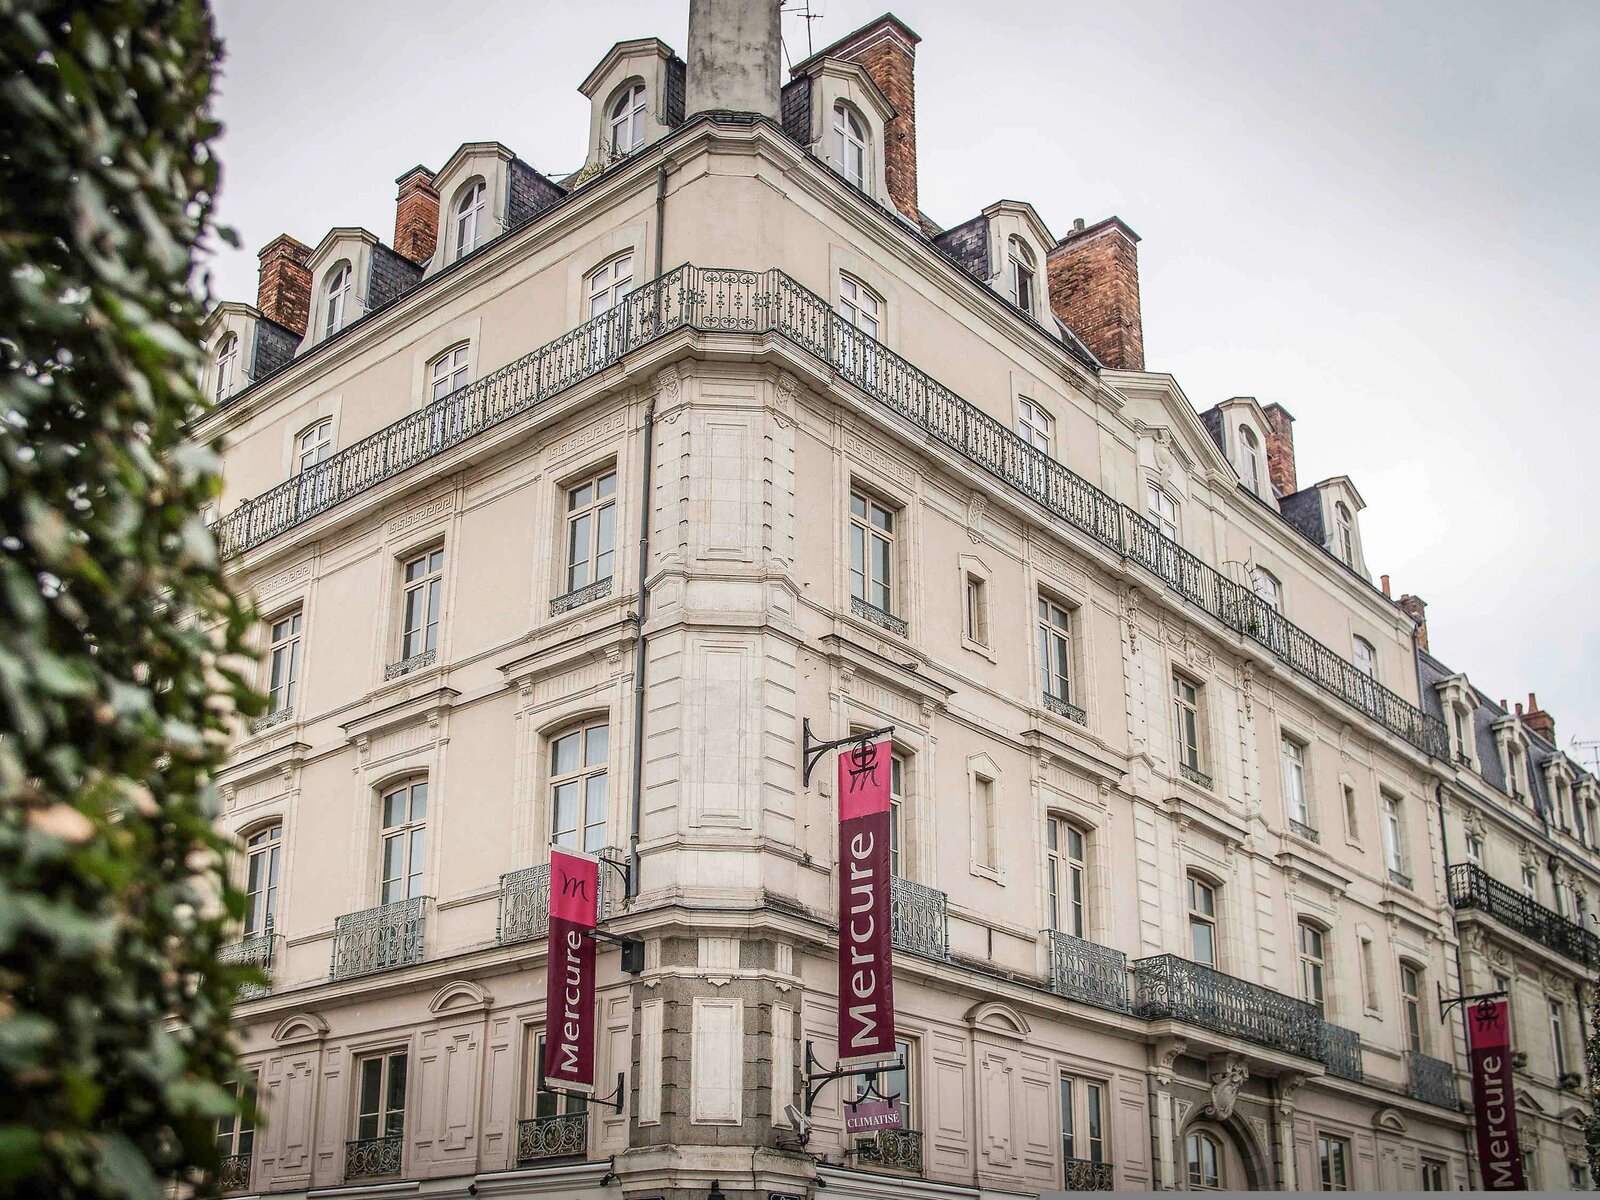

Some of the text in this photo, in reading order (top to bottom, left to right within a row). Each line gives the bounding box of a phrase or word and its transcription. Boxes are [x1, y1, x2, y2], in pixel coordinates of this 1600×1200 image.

[560, 930, 582, 1073] Mercure
[849, 831, 879, 1048] Mercure
[847, 1110, 900, 1128] CLIMATISÉ
[1483, 1055, 1514, 1188] Mercure
